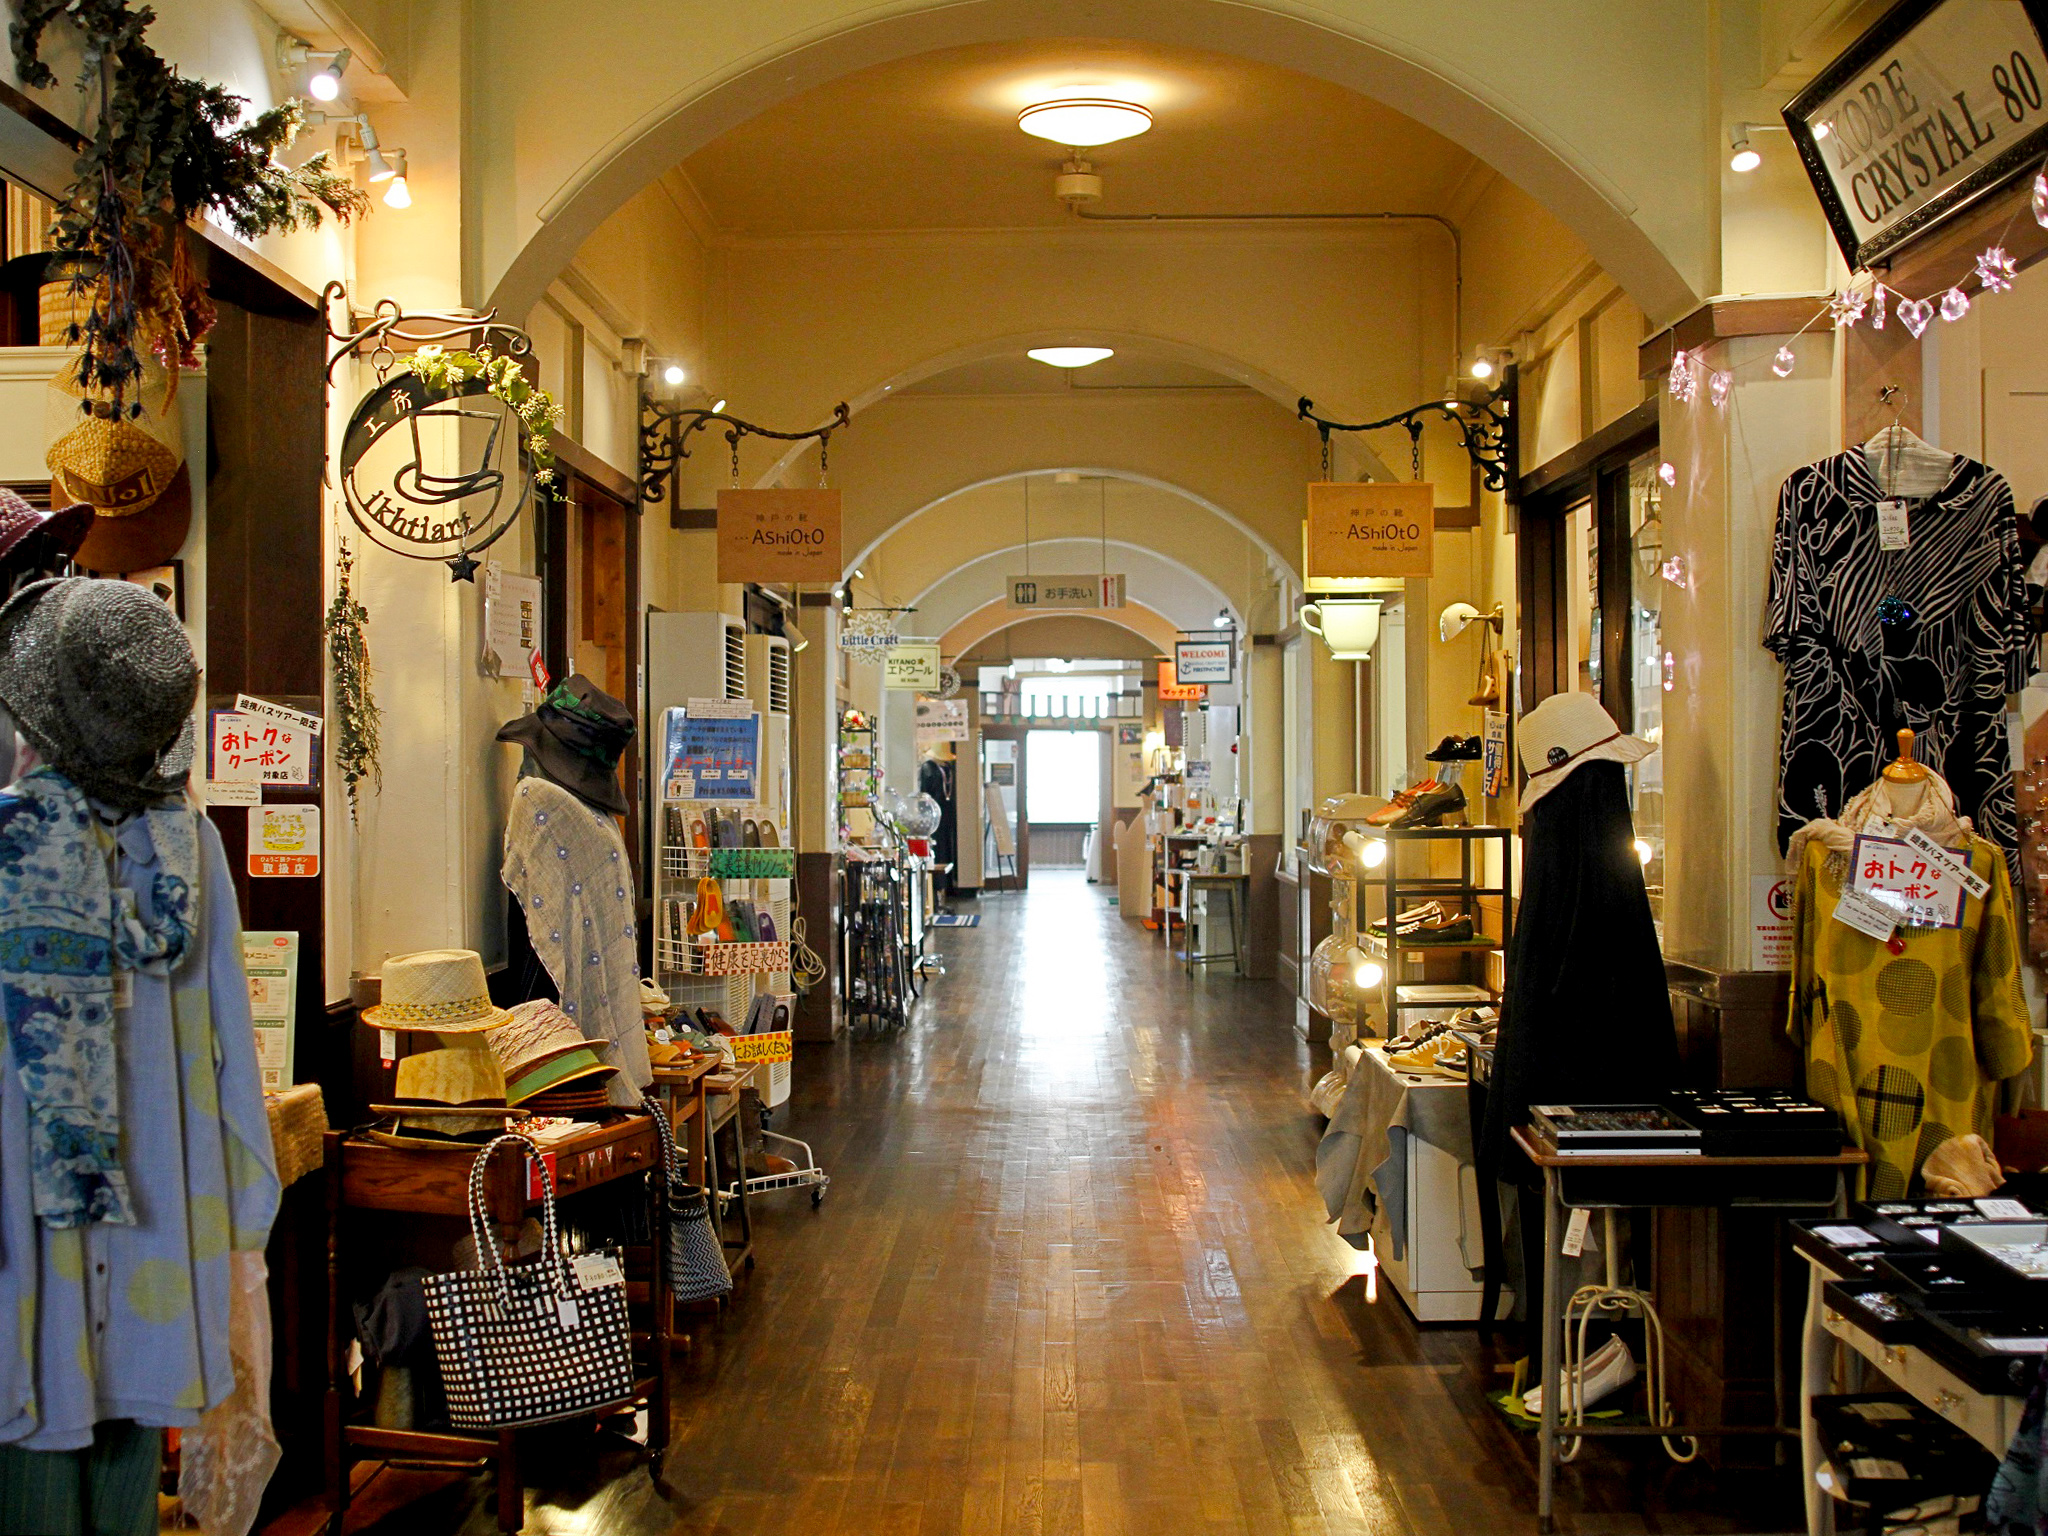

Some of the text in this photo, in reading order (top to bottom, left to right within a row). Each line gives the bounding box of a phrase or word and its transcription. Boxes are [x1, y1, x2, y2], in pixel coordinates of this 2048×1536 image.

[1827, 59, 1920, 170] KOBE
[1851, 50, 2042, 224] CRYSTAL 80
[1397, 542, 1419, 553] Japan
[1044, 587, 1093, 599] お手洗い
[841, 633, 899, 646] Little Craft
[888, 658, 917, 666] KITANO
[1180, 650, 1227, 658] WELCOME
[887, 666, 934, 676] エトワール
[240, 698, 319, 731] 提携バスツアー限定
[222, 727, 293, 752] おトクな
[228, 749, 291, 769] クーポン
[1486, 741, 1496, 794] サービス
[263, 770, 290, 780] 対象店
[262, 863, 305, 875] 取扱店
[1864, 860, 1942, 880] おトクな
[1909, 834, 1984, 893] 提携バスツアー限定
[711, 949, 785, 971] 健康を足裏から
